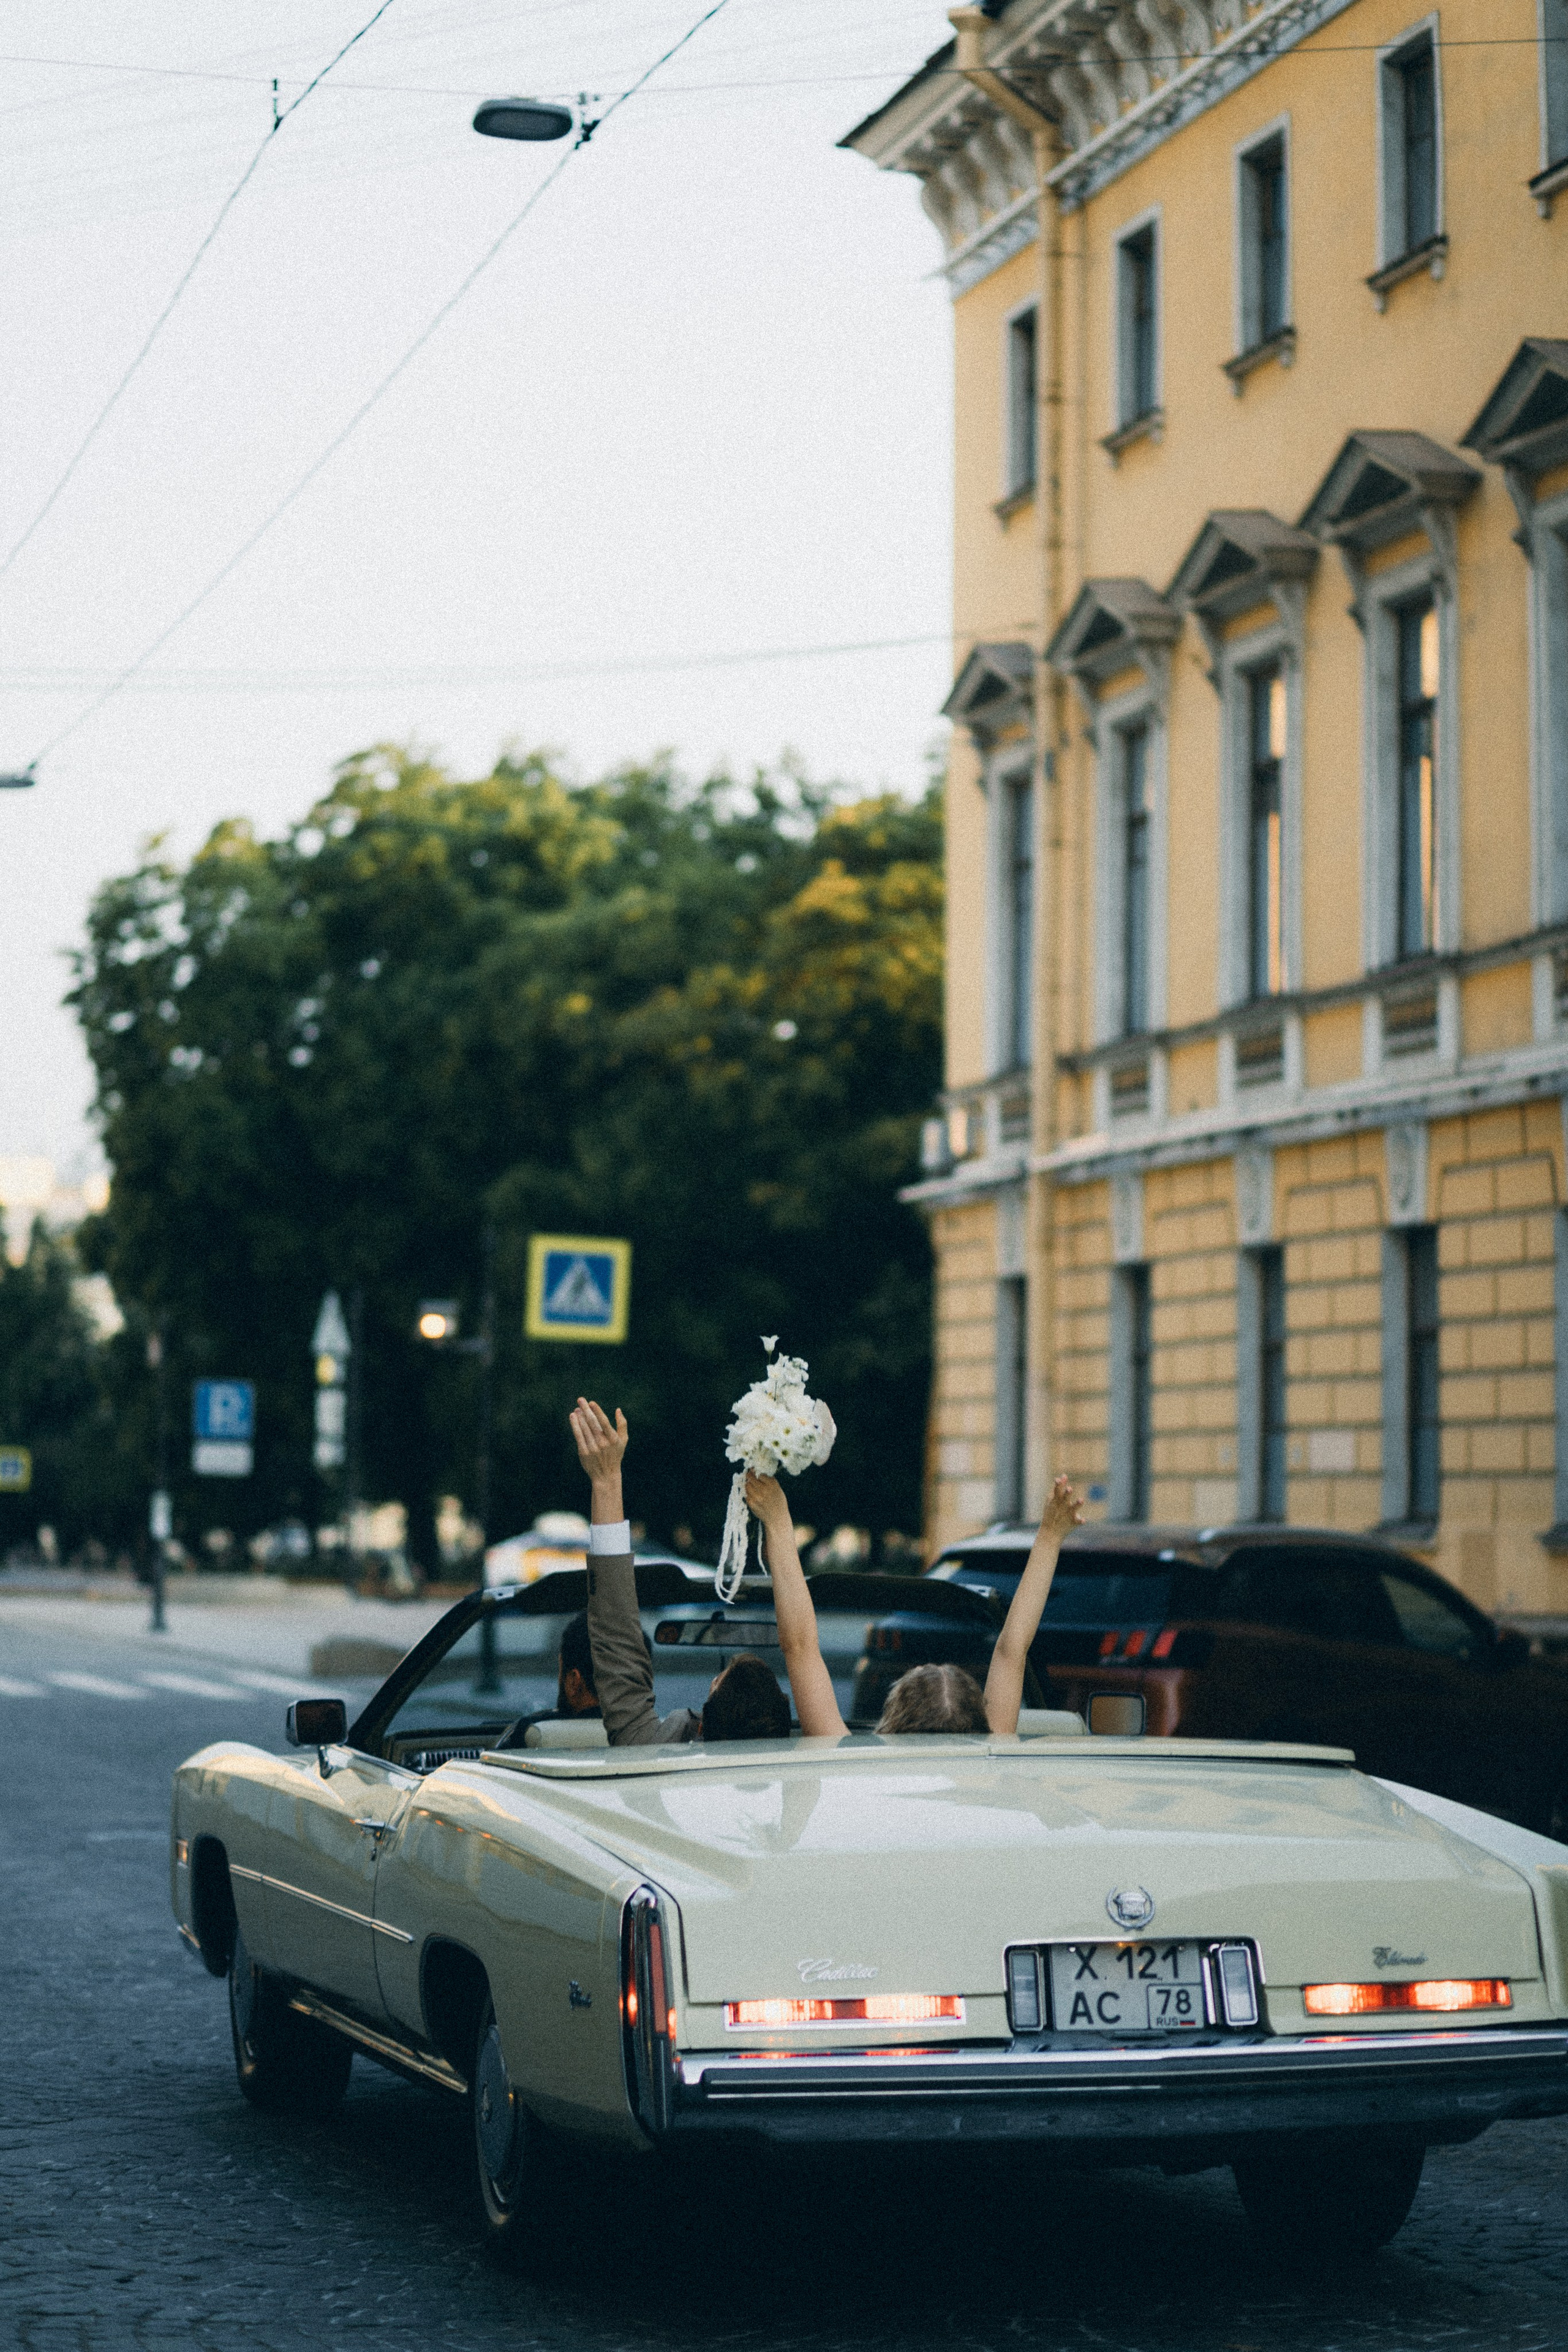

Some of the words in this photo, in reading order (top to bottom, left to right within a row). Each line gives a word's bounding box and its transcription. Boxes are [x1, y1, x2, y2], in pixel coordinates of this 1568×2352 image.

[797, 1959, 879, 1983] Cadillac
[1075, 1946, 1099, 1980] X
[1116, 1946, 1180, 1979] 121
[1069, 1991, 1121, 2025] AC
[1156, 1989, 1192, 2015] 78
[1156, 2017, 1179, 2026] RUS
